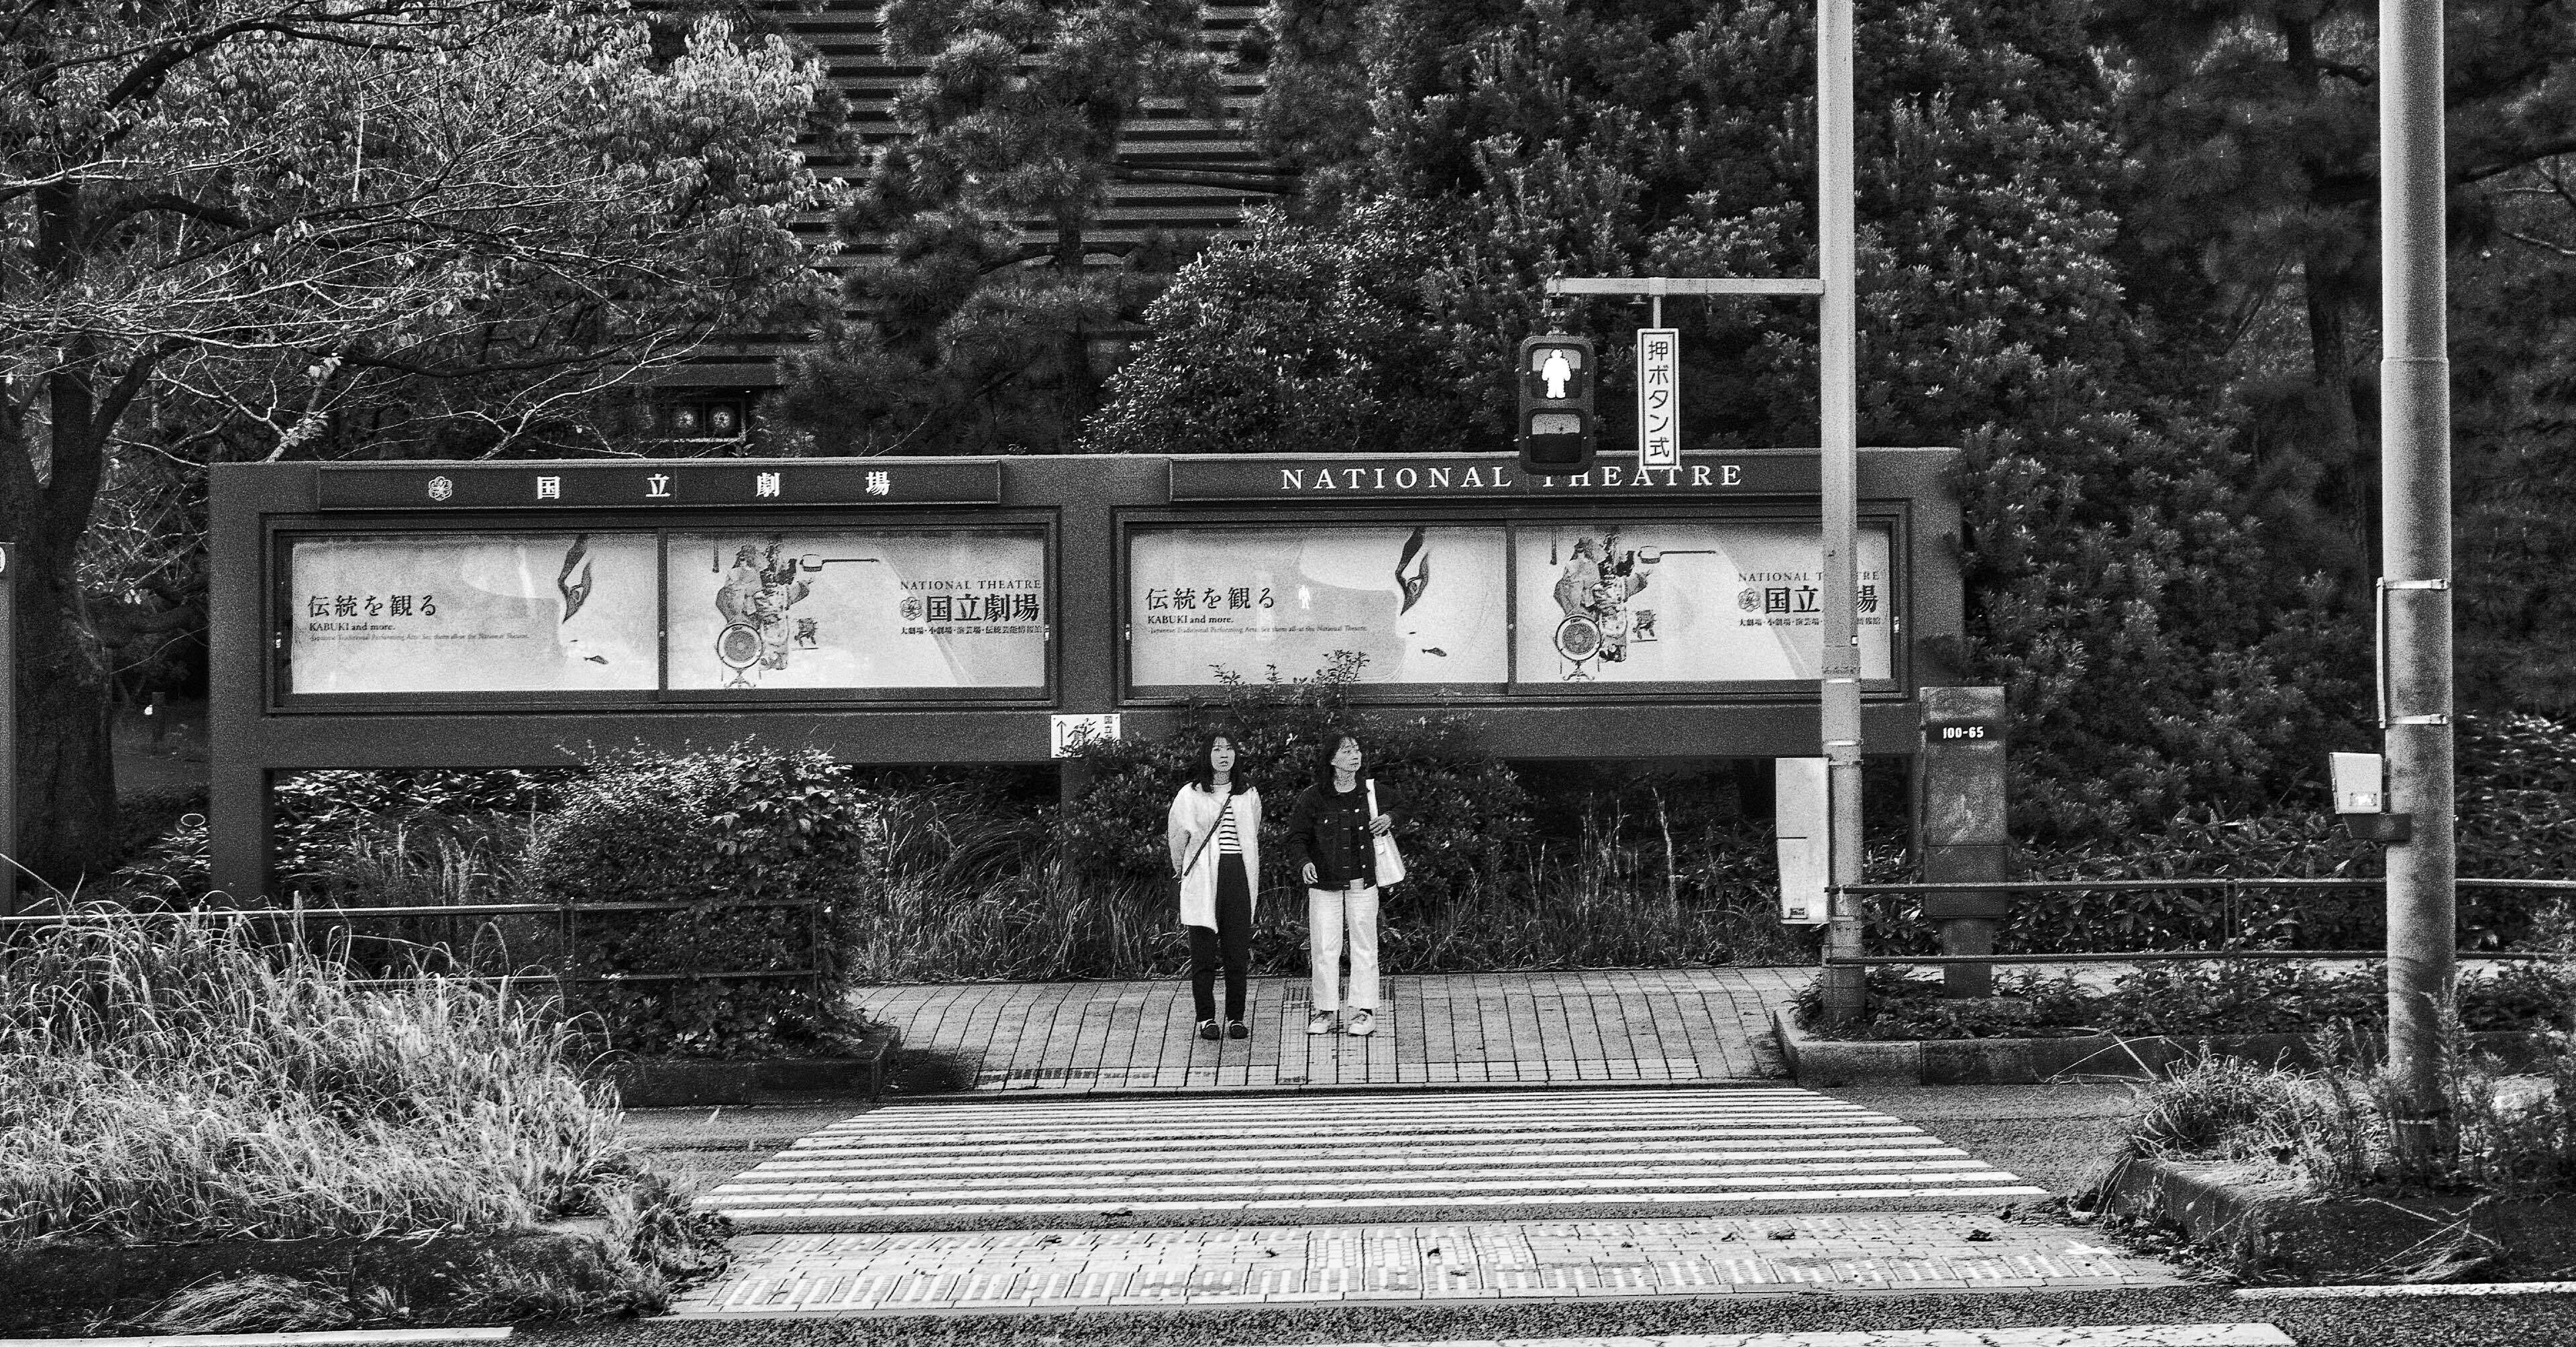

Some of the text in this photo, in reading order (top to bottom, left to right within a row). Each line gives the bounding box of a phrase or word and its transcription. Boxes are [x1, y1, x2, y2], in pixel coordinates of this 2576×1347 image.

[1648, 340, 1670, 458] 押ボタン式
[537, 471, 891, 500] 国立劇場
[1281, 466, 1513, 490] NATIONAL
[900, 580, 1041, 590] NATIONAL THEATRE
[1738, 572, 1809, 582] NATIONAL
[307, 594, 436, 618] 伝統を観る
[926, 593, 1040, 623] 国立劇場
[1146, 587, 1275, 610] 伝統を観る
[1765, 585, 1879, 614] 国立場
[309, 622, 350, 631] KABUKI
[351, 622, 368, 631] and
[1148, 615, 1188, 624] KABUKI
[1189, 614, 1206, 624] and
[1943, 726, 1984, 739] 100-65
